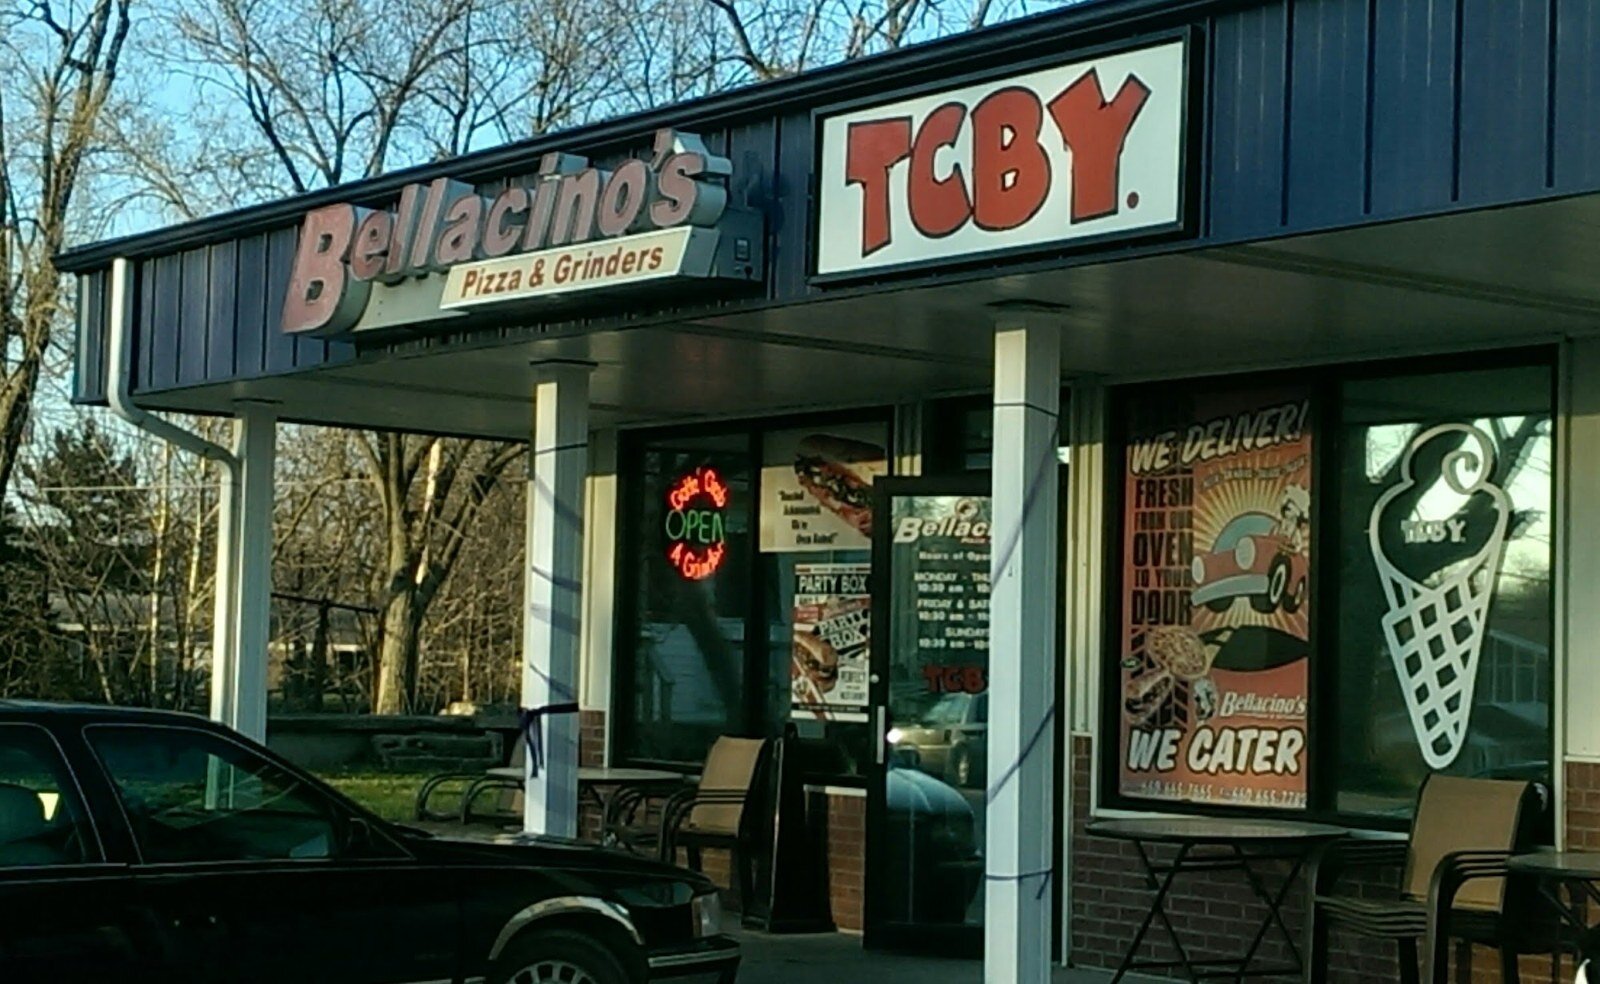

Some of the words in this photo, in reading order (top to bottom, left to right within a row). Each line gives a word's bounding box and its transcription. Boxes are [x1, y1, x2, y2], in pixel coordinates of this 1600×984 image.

[282, 129, 708, 333] Bellacino's
[461, 268, 521, 298] Pizza
[528, 259, 545, 288] &
[553, 244, 663, 284] Grinders
[1132, 431, 1177, 474] WE
[1181, 401, 1309, 464] DELIVER!
[1135, 477, 1194, 509] FRESH
[666, 509, 725, 544] OPEN
[952, 551, 964, 560] of
[1133, 531, 1194, 567] OVEN
[799, 574, 838, 593] PARTY
[841, 574, 867, 593] BOX
[914, 572, 957, 581] MONDAY
[1134, 569, 1150, 588] TO
[917, 600, 952, 609] FRIDAY
[1131, 589, 1192, 626] DOOR
[820, 611, 868, 636] PARTY
[830, 627, 867, 649] BOX
[922, 663, 988, 694] TCB
[1220, 691, 1307, 718] Bellacino's
[1128, 728, 1182, 770] WE
[1187, 728, 1304, 773] CATER
